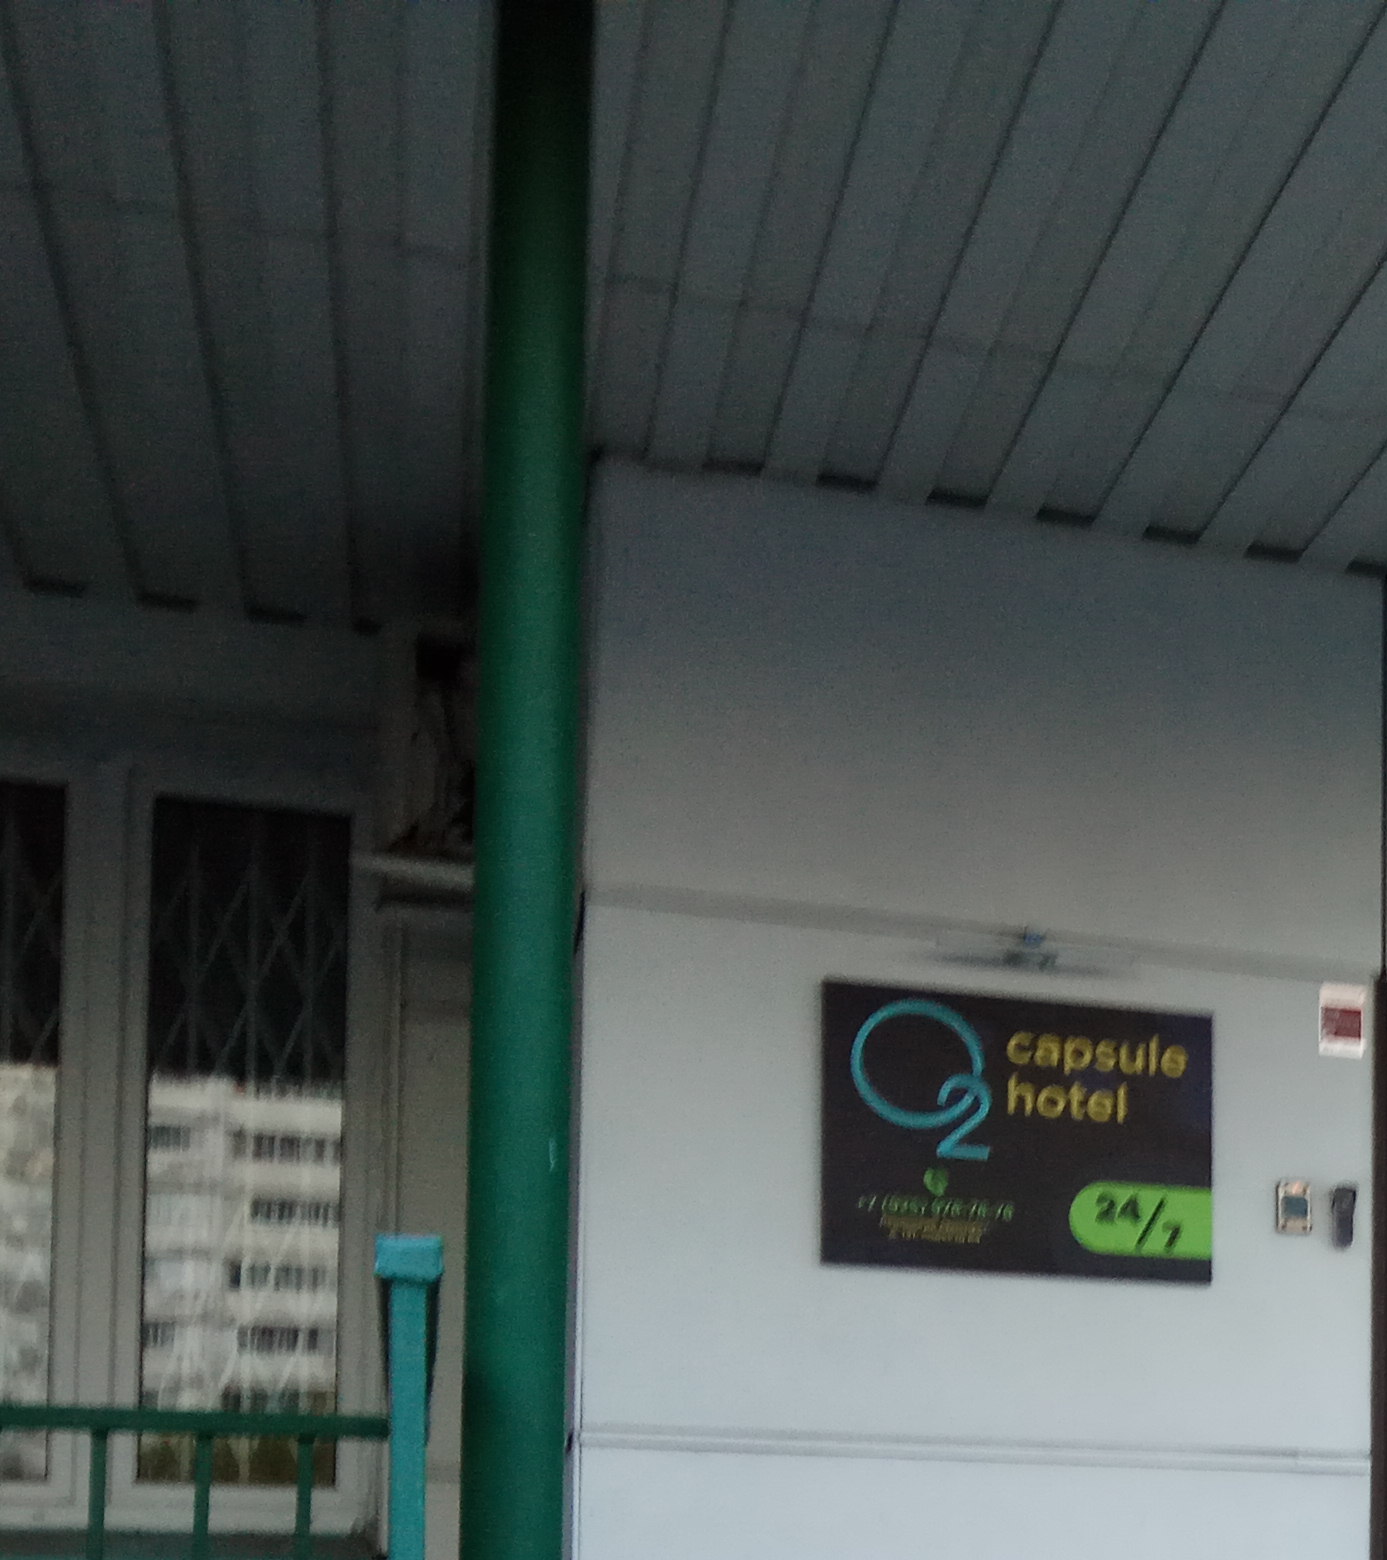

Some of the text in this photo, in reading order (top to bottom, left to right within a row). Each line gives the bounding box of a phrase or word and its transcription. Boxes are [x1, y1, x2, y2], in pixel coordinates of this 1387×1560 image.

[1006, 1030, 1188, 1078] capsule
[1007, 1073, 1128, 1124] hotel
[1095, 1190, 1182, 1253] 24/7
